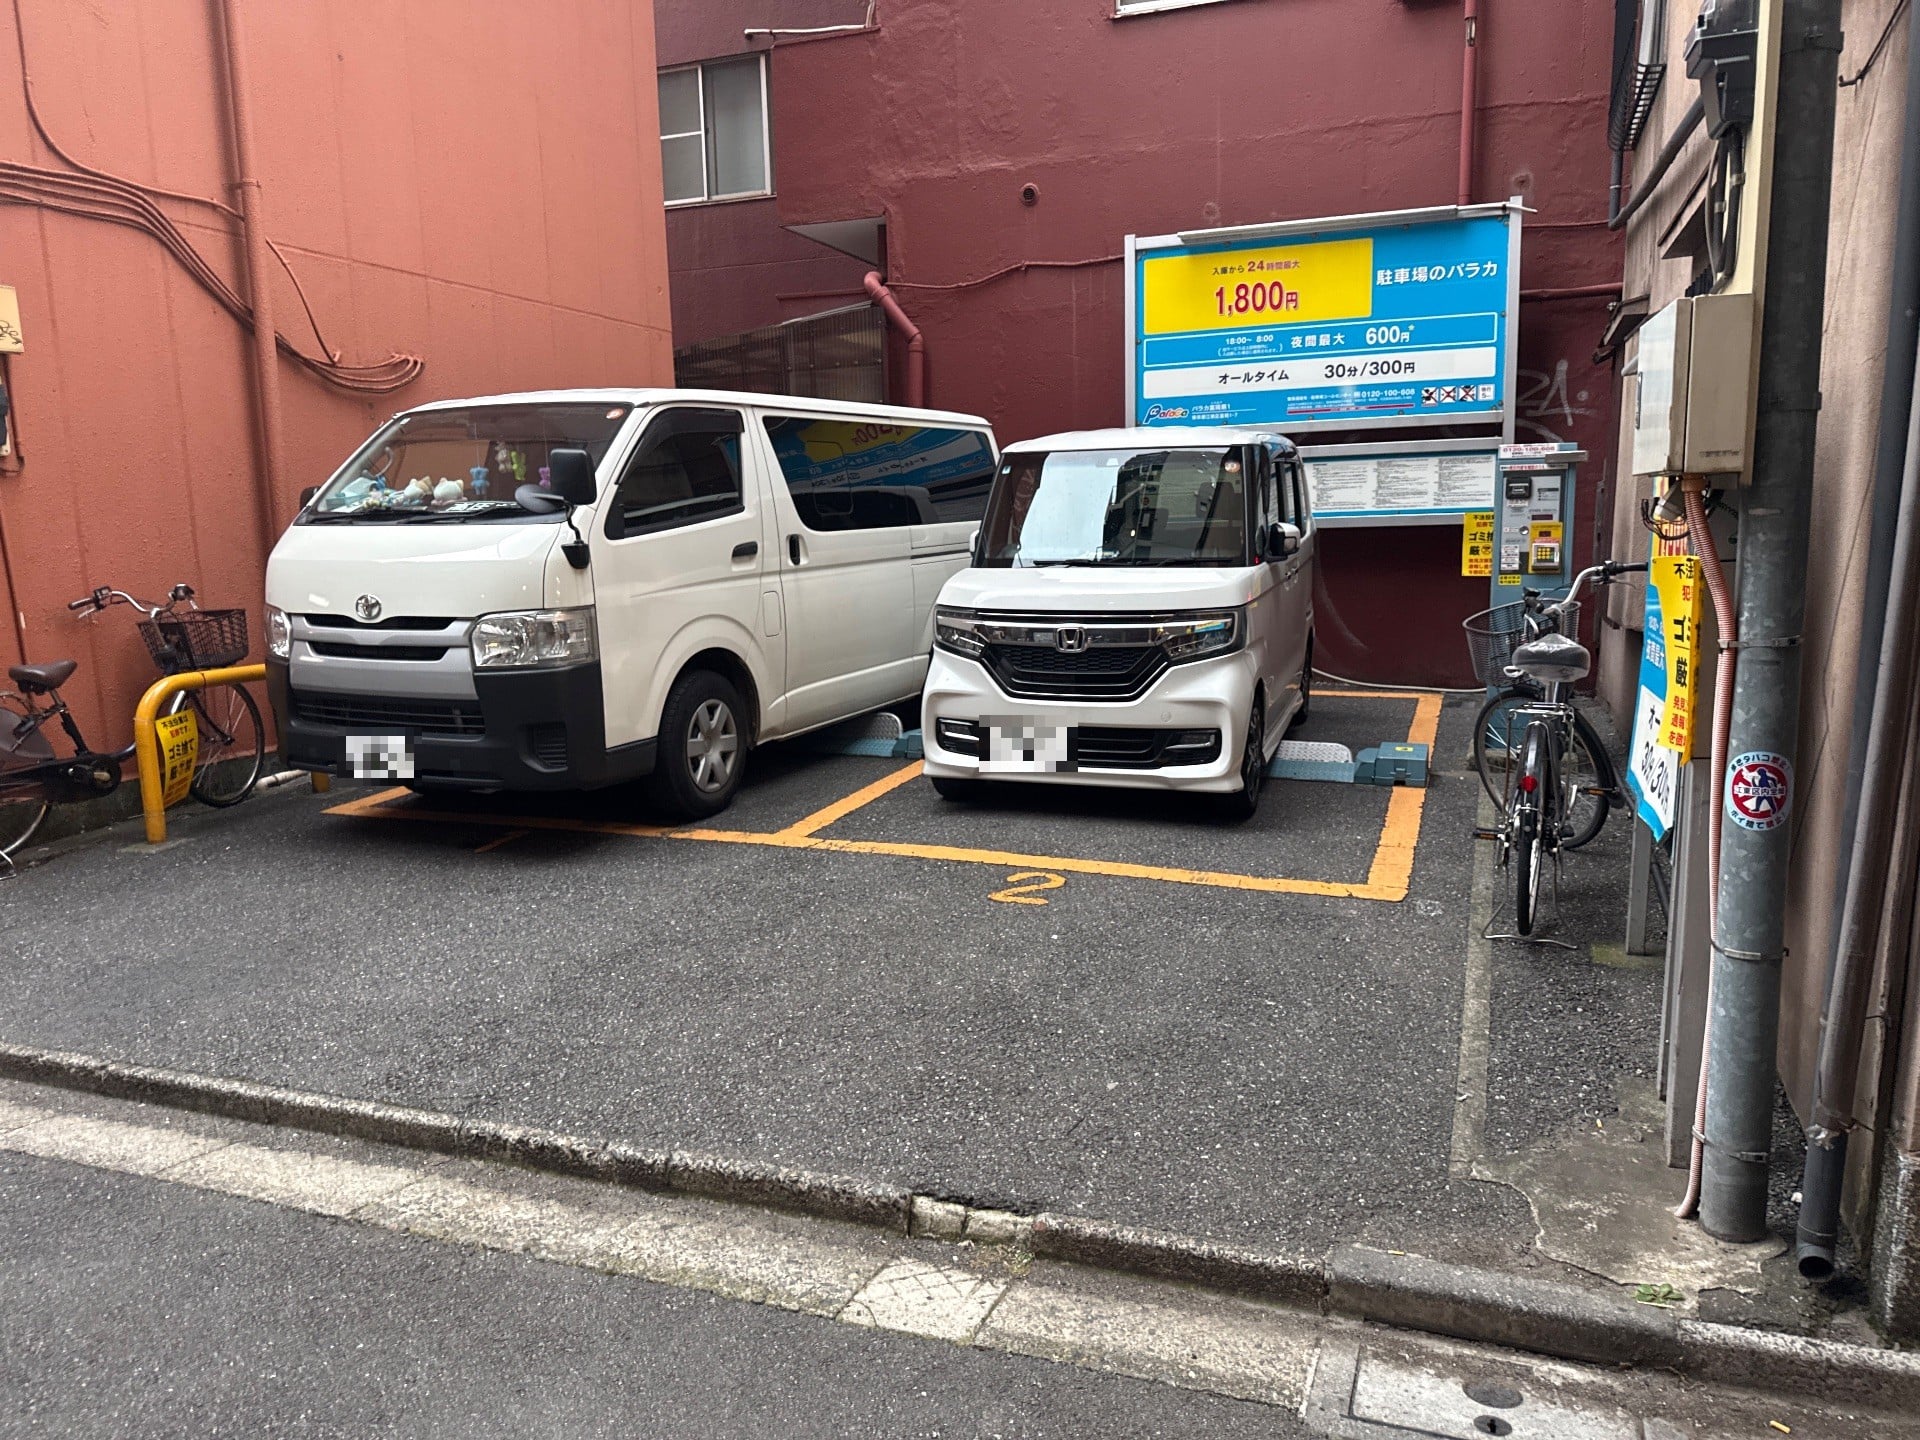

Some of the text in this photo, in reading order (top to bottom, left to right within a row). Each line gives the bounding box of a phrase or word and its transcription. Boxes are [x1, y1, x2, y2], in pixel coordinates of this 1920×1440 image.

[1376, 260, 1499, 286] 駐車場のパラカ
[1215, 281, 1299, 318] 1,800円
[1291, 333, 1346, 349] 夜間最大
[1218, 360, 1416, 385] オールタイム 30分/300円
[987, 871, 1067, 905] 2
